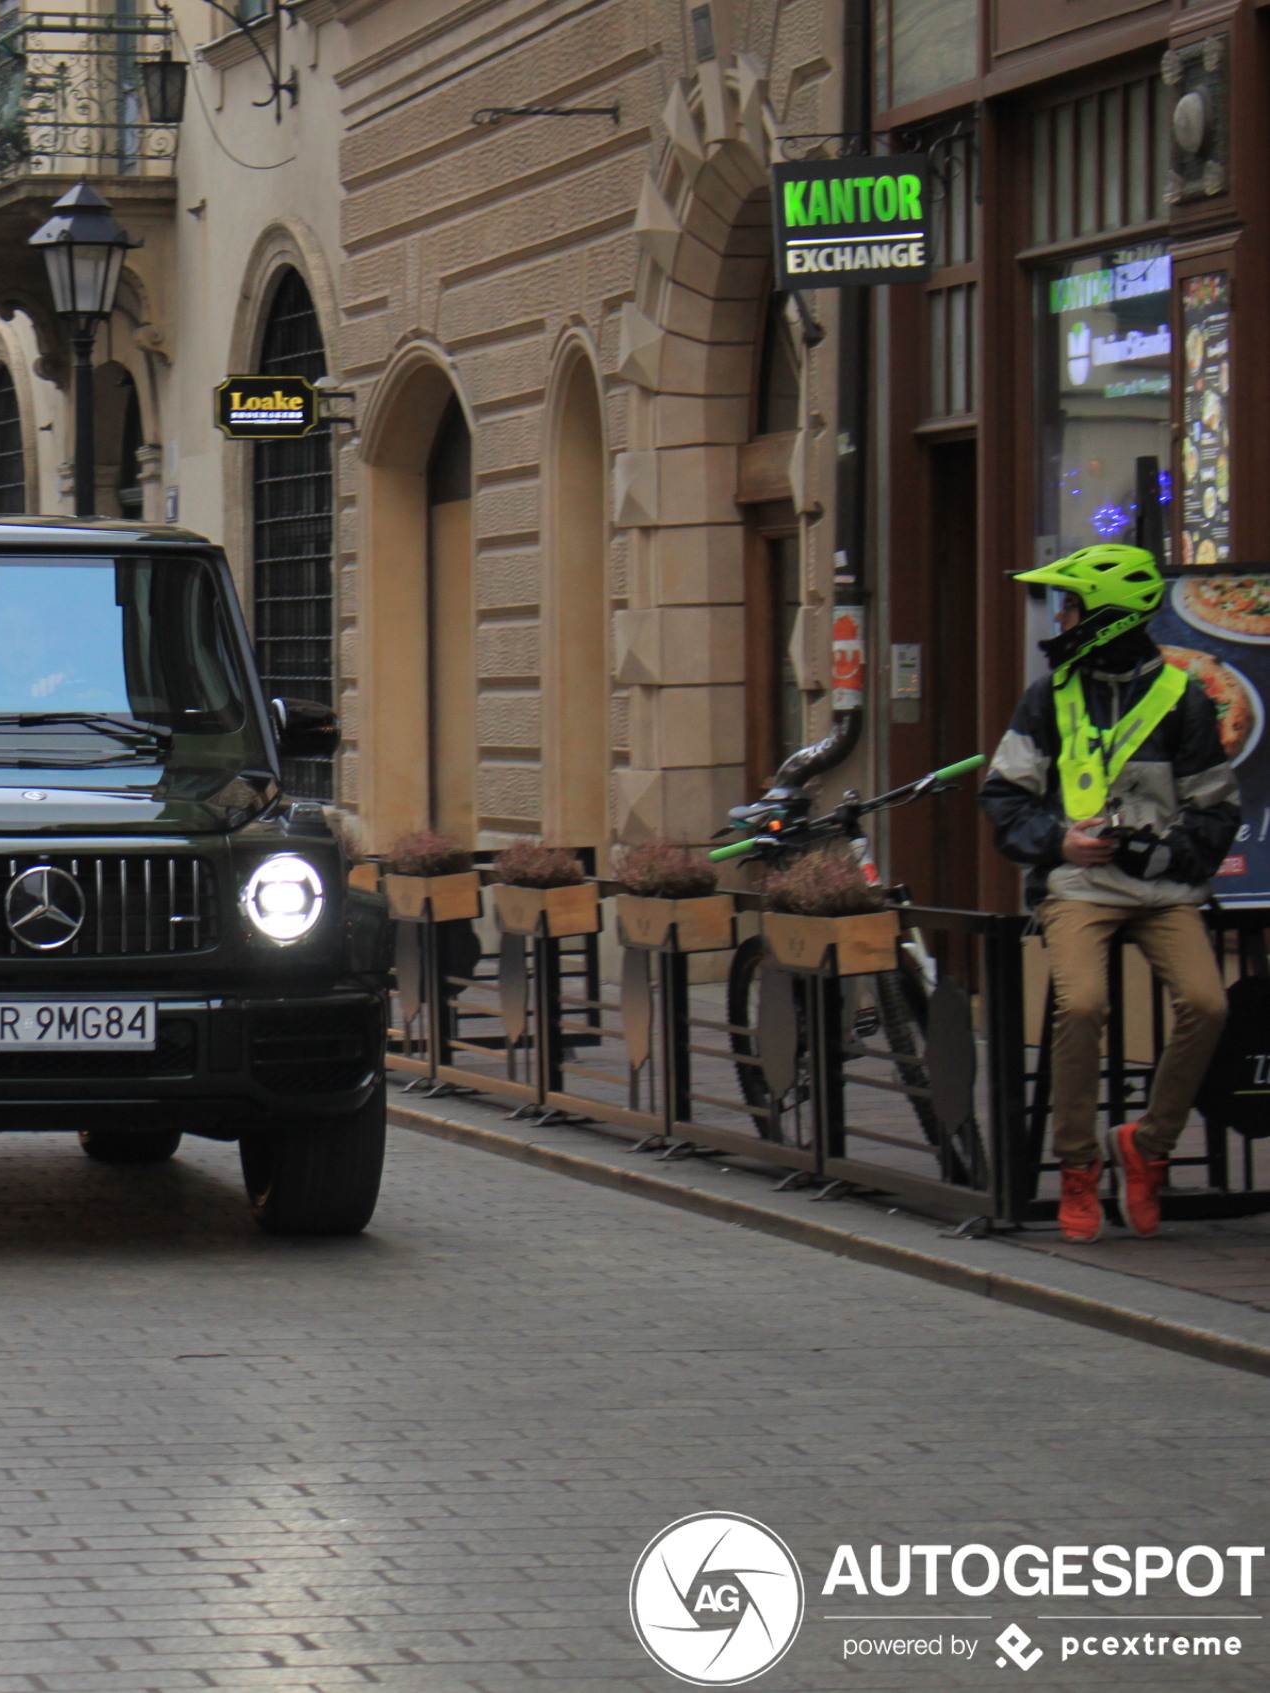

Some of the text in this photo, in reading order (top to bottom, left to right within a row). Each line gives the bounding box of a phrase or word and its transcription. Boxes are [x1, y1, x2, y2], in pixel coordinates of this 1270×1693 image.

[784, 174, 923, 227] KANTOR
[786, 242, 925, 273] EXCHANGE
[230, 391, 304, 411] Loake
[36, 1006, 146, 1040] 9MG84
